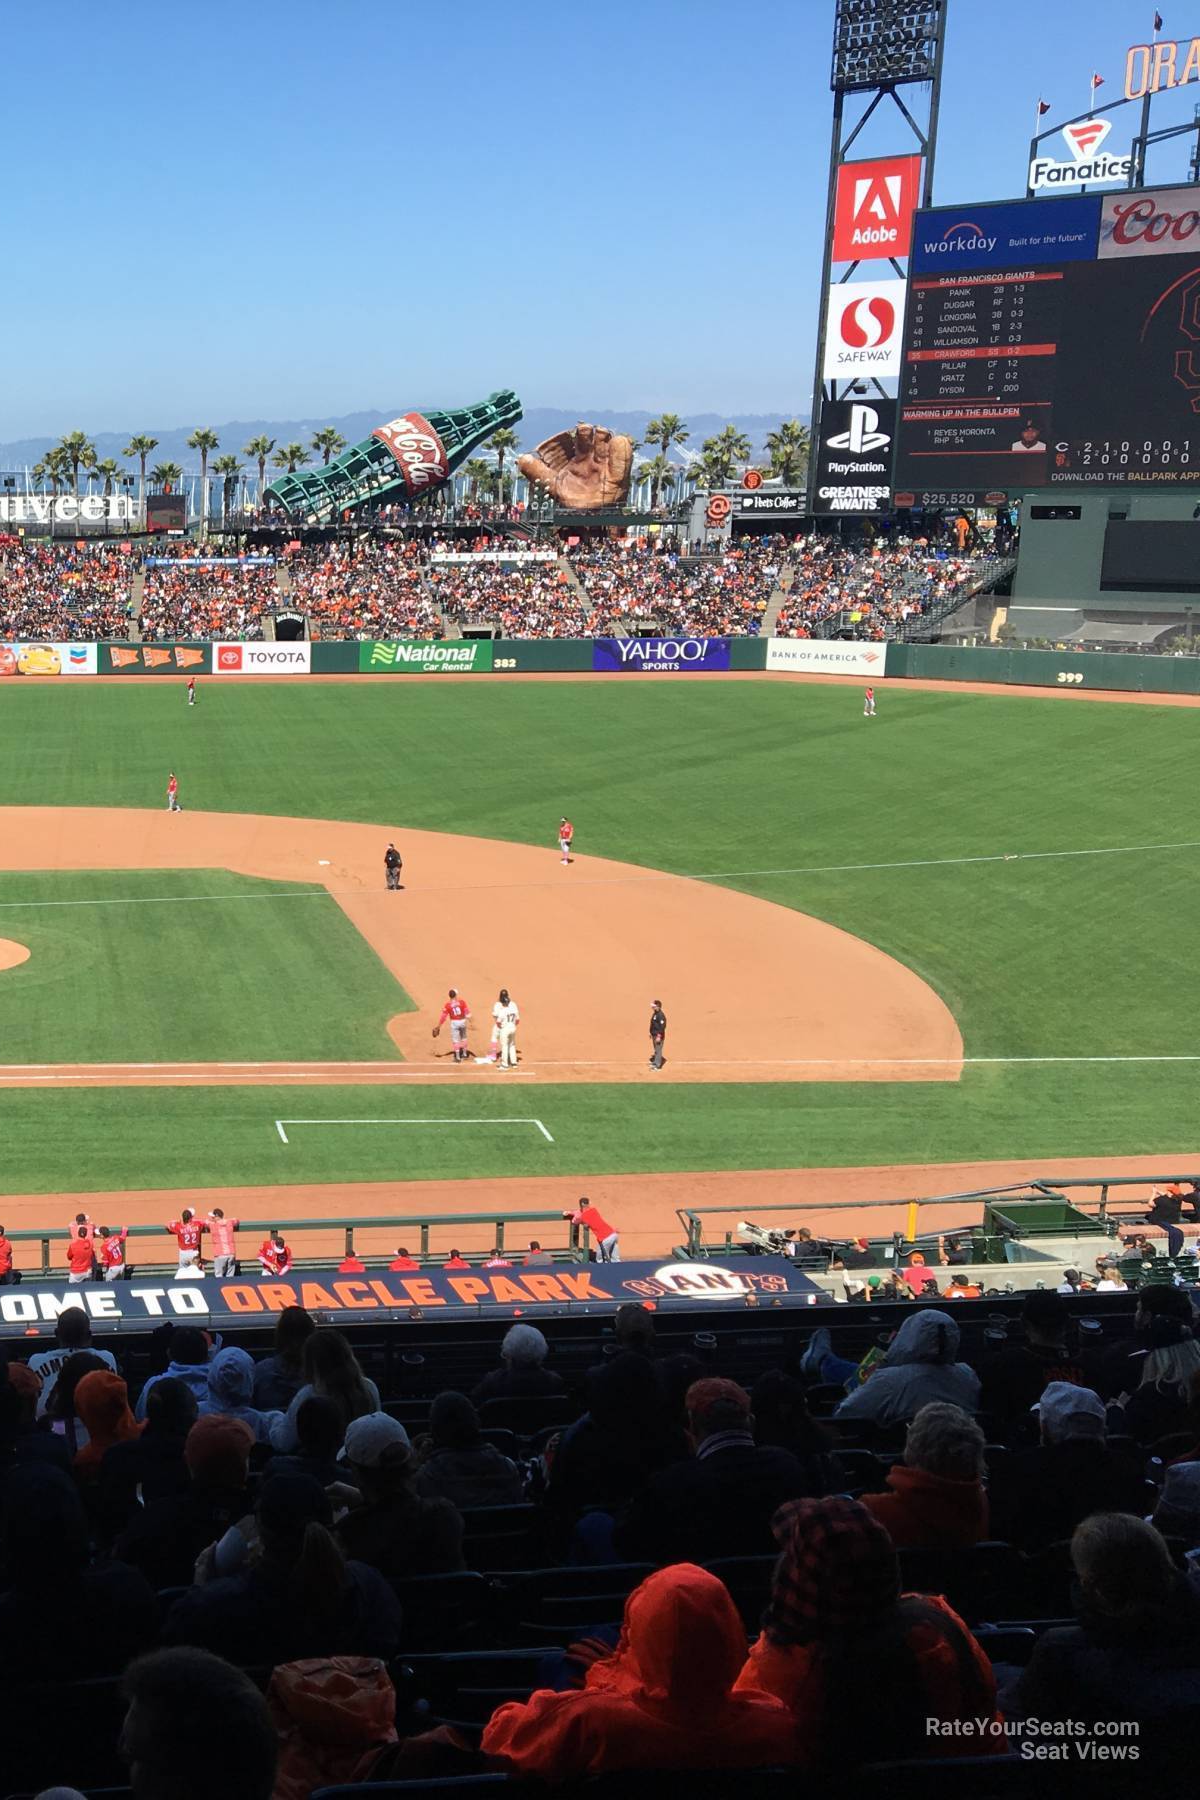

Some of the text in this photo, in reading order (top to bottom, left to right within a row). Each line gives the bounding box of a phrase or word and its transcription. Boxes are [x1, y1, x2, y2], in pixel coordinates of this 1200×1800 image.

[1034, 157, 1131, 184] Fanatics
[851, 225, 897, 245] Adobe
[924, 236, 997, 253] workday
[1009, 237, 1027, 247] Built
[1029, 236, 1041, 245] for
[1043, 235, 1056, 244] the
[939, 271, 1035, 285] SAN FRANCISCO GIANTS
[943, 301, 975, 309] DUGGAR
[940, 313, 977, 322] LONGORIA
[937, 325, 976, 334] SANDOVAL
[992, 323, 1000, 331] 1B
[933, 337, 979, 346] WILLIAMSON
[837, 350, 892, 363] SAFEWAY
[941, 362, 967, 370] PILLAR
[988, 360, 998, 368] CF
[941, 374, 965, 382] KRATZ
[903, 409, 940, 418] WARMING
[942, 409, 953, 417] UP
[965, 408, 980, 416] THE
[983, 408, 1020, 416] BULLPEN
[959, 428, 996, 436] MORONTA
[1084, 442, 1092, 452] 2
[1104, 442, 1110, 452] 1
[1121, 441, 1129, 452] 0
[1143, 441, 1152, 451] 0
[1163, 441, 1171, 451] 0
[1183, 441, 1190, 451] 1
[1083, 453, 1189, 464] 2 0 0 0 0 0
[1051, 472, 1200, 481] DOWNLOAD THE BALLPARK APP
[774, 496, 797, 509] Coffee
[922, 492, 975, 505] $25,520
[395, 643, 478, 662] National
[617, 639, 709, 662] YAHOO!
[248, 652, 305, 663] TOYOTA
[771, 651, 857, 662] BANK OF AMERICA
[423, 663, 472, 671] Car Rental
[494, 658, 517, 668] 382
[642, 662, 680, 671] SPORTS
[1057, 672, 1083, 684] 399
[507, 1013, 516, 1022] 17
[184, 1233, 197, 1245] 22
[622, 1272, 788, 1298] GIANTS
[130, 1287, 210, 1316] TO
[219, 1277, 447, 1313] ORACLE
[448, 1271, 614, 1304] PARK
